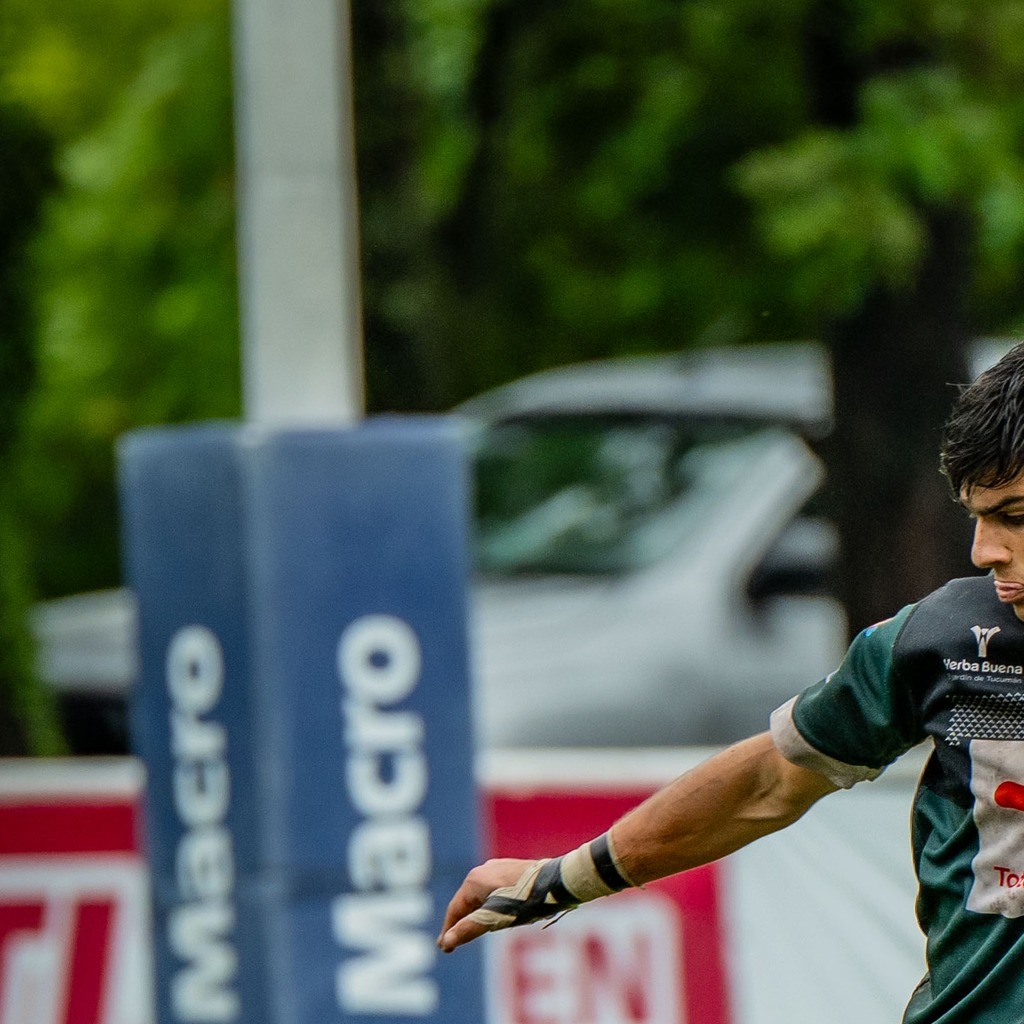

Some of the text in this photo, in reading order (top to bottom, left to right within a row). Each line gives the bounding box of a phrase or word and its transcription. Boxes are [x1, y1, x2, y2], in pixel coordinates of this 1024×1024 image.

[165, 625, 242, 1024] Macro
[333, 612, 439, 1016] Macro
[943, 658, 1023, 675] Yerba Buena
